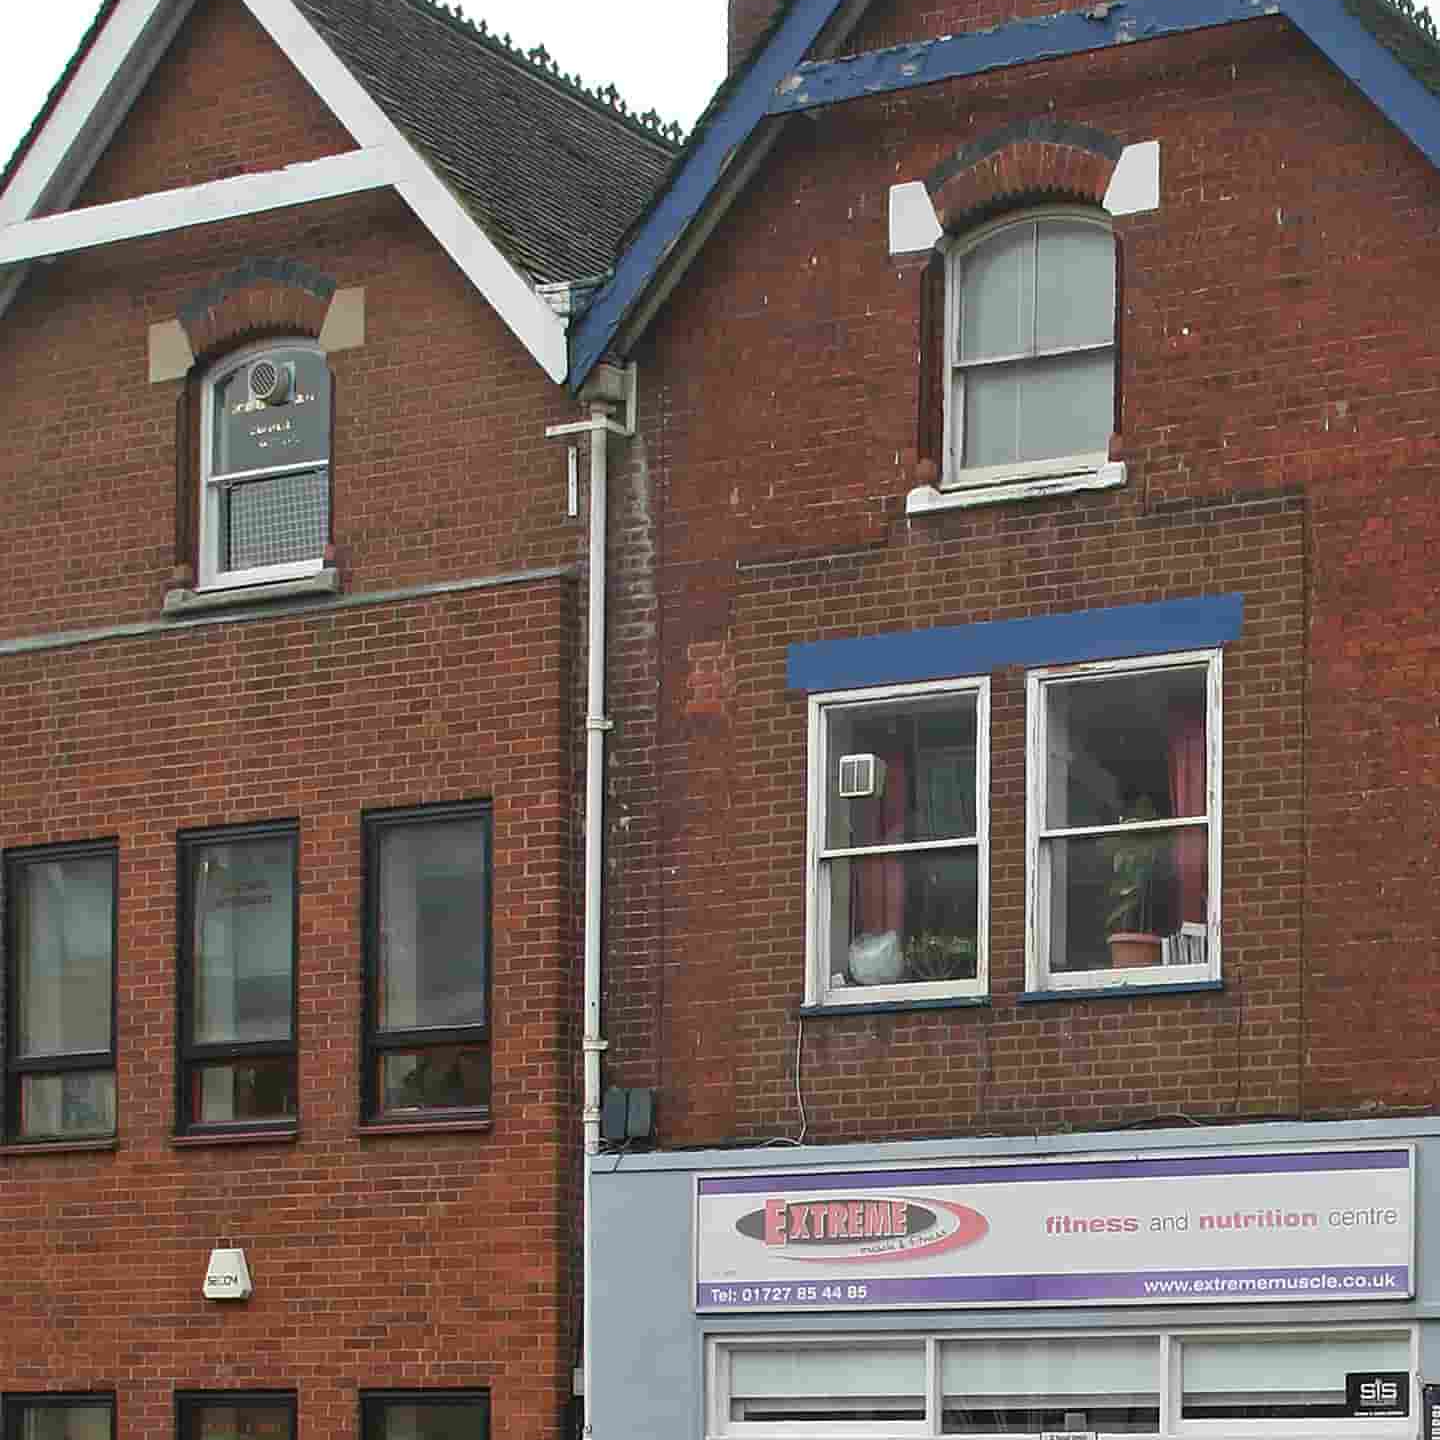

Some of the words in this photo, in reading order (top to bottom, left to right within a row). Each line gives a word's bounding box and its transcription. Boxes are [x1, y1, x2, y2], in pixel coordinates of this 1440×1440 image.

[765, 1198, 908, 1248] EXTREME
[1045, 1215, 1139, 1234] fitness
[1150, 1212, 1189, 1232] and
[1199, 1209, 1318, 1231] nutrition
[1328, 1208, 1398, 1227] centre
[711, 1288, 737, 1303] Tel:
[742, 1288, 792, 1303] 01727
[797, 1287, 818, 1301] 85
[822, 1286, 842, 1300] 44
[1144, 1272, 1396, 1294] www.extrememuscle.co.uk
